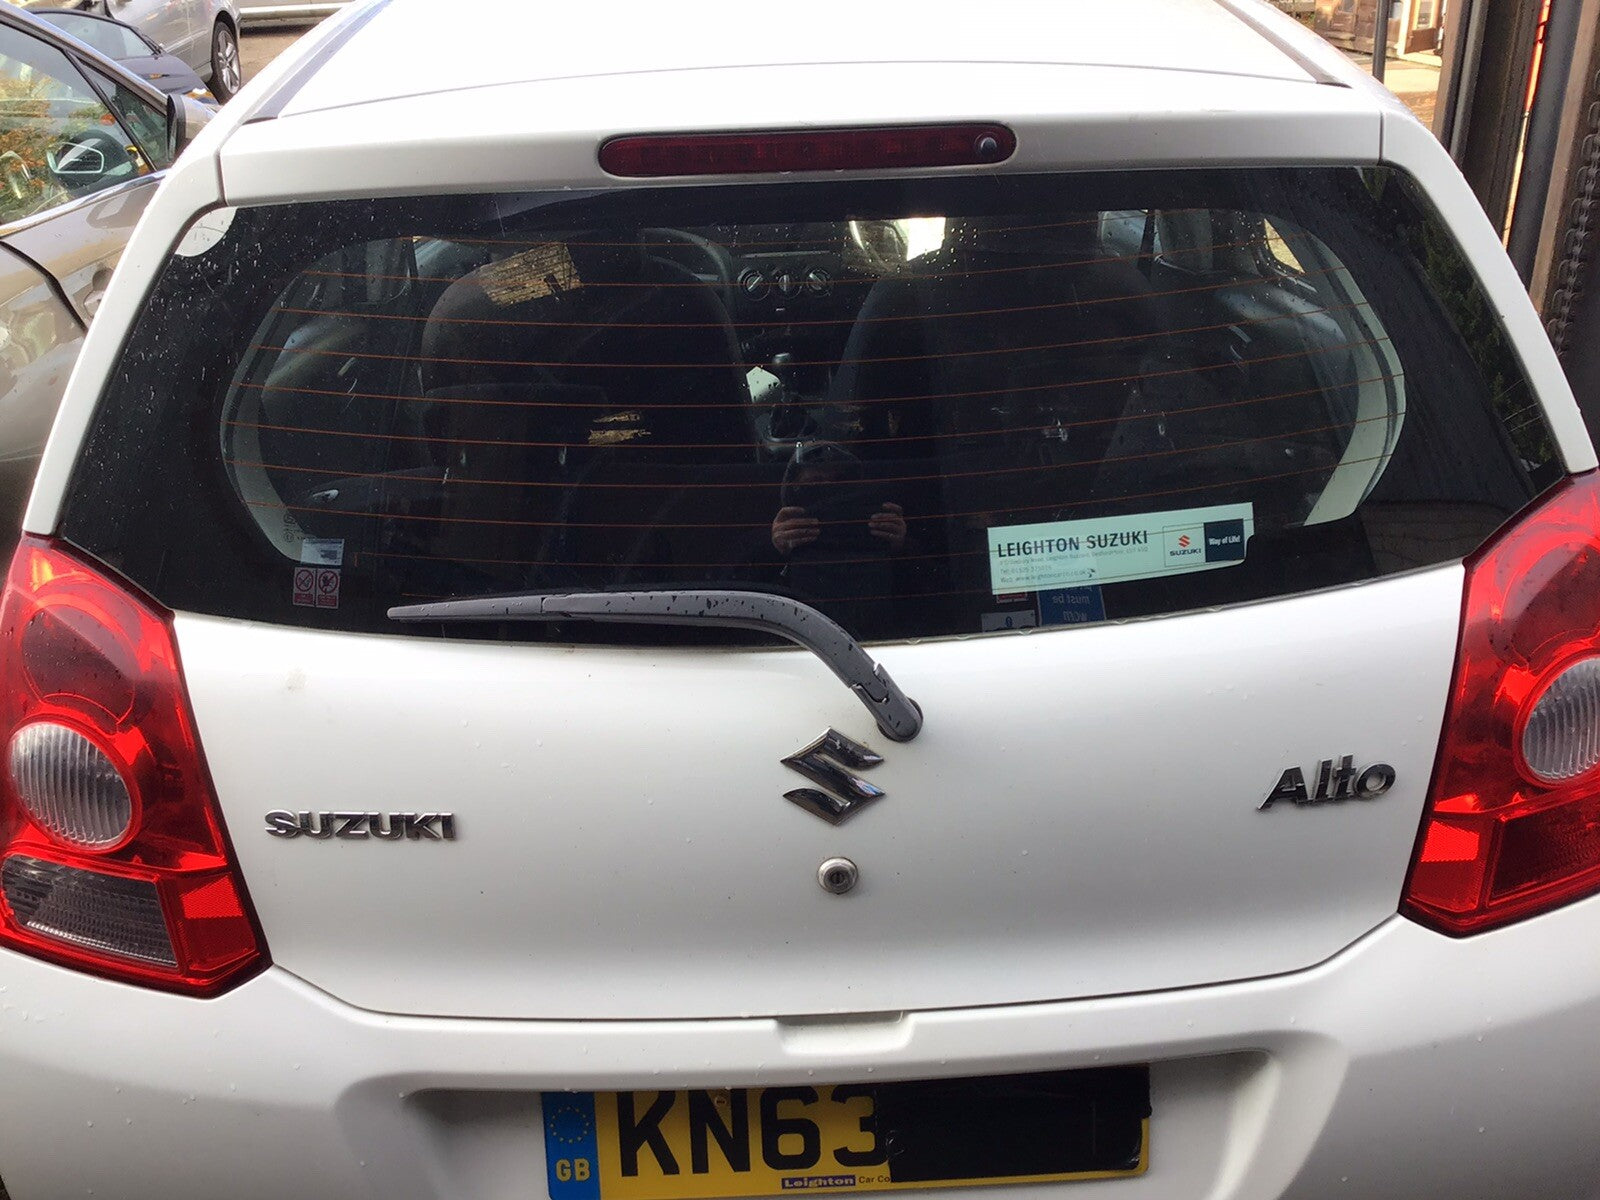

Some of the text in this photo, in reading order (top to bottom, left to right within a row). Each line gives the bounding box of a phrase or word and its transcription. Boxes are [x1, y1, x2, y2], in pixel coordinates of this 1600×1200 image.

[997, 537, 1080, 558] LEIGHTON
[1086, 530, 1148, 549] SUZUKI
[1169, 548, 1202, 557] SUZUKI
[1208, 537, 1221, 546] Way
[1222, 536, 1228, 544] of
[1256, 754, 1396, 810] Alto
[264, 809, 457, 840] SUZUKI
[616, 1085, 887, 1177] KN63
[555, 1158, 591, 1182] GB
[783, 1177, 855, 1188] Leighton
[859, 1175, 875, 1184] Car
